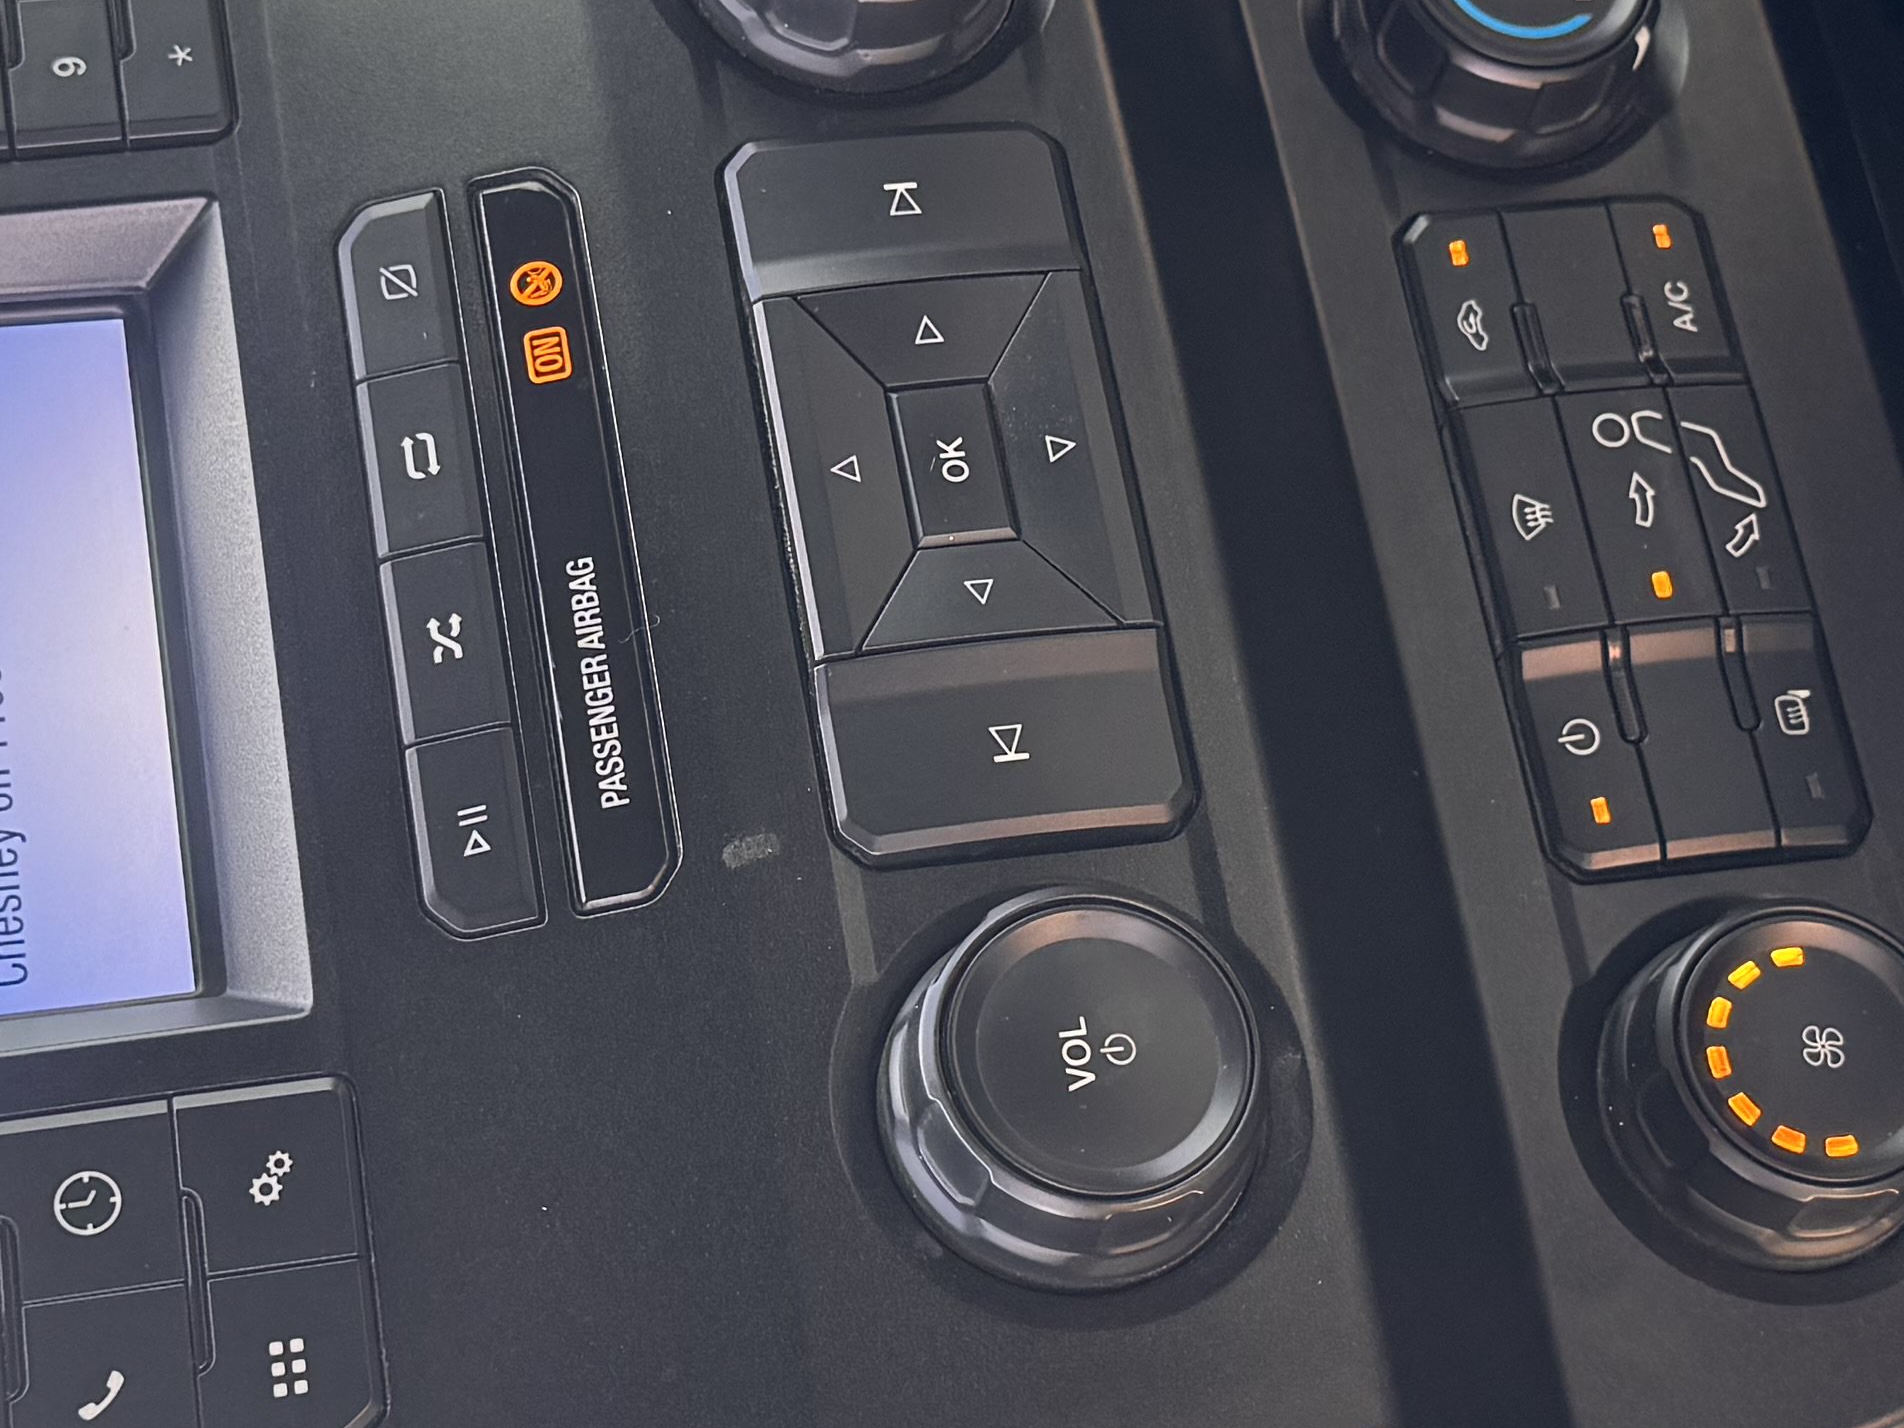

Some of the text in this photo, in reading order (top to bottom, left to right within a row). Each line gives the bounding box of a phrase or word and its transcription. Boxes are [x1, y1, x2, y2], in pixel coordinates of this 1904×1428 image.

[52, 56, 87, 77] 9
[1663, 281, 1697, 332] A/C
[531, 336, 565, 373] ON
[930, 436, 970, 483] OK
[565, 556, 630, 809] PASSENGER AIRBAG
[1058, 1016, 1095, 1092] VOL
